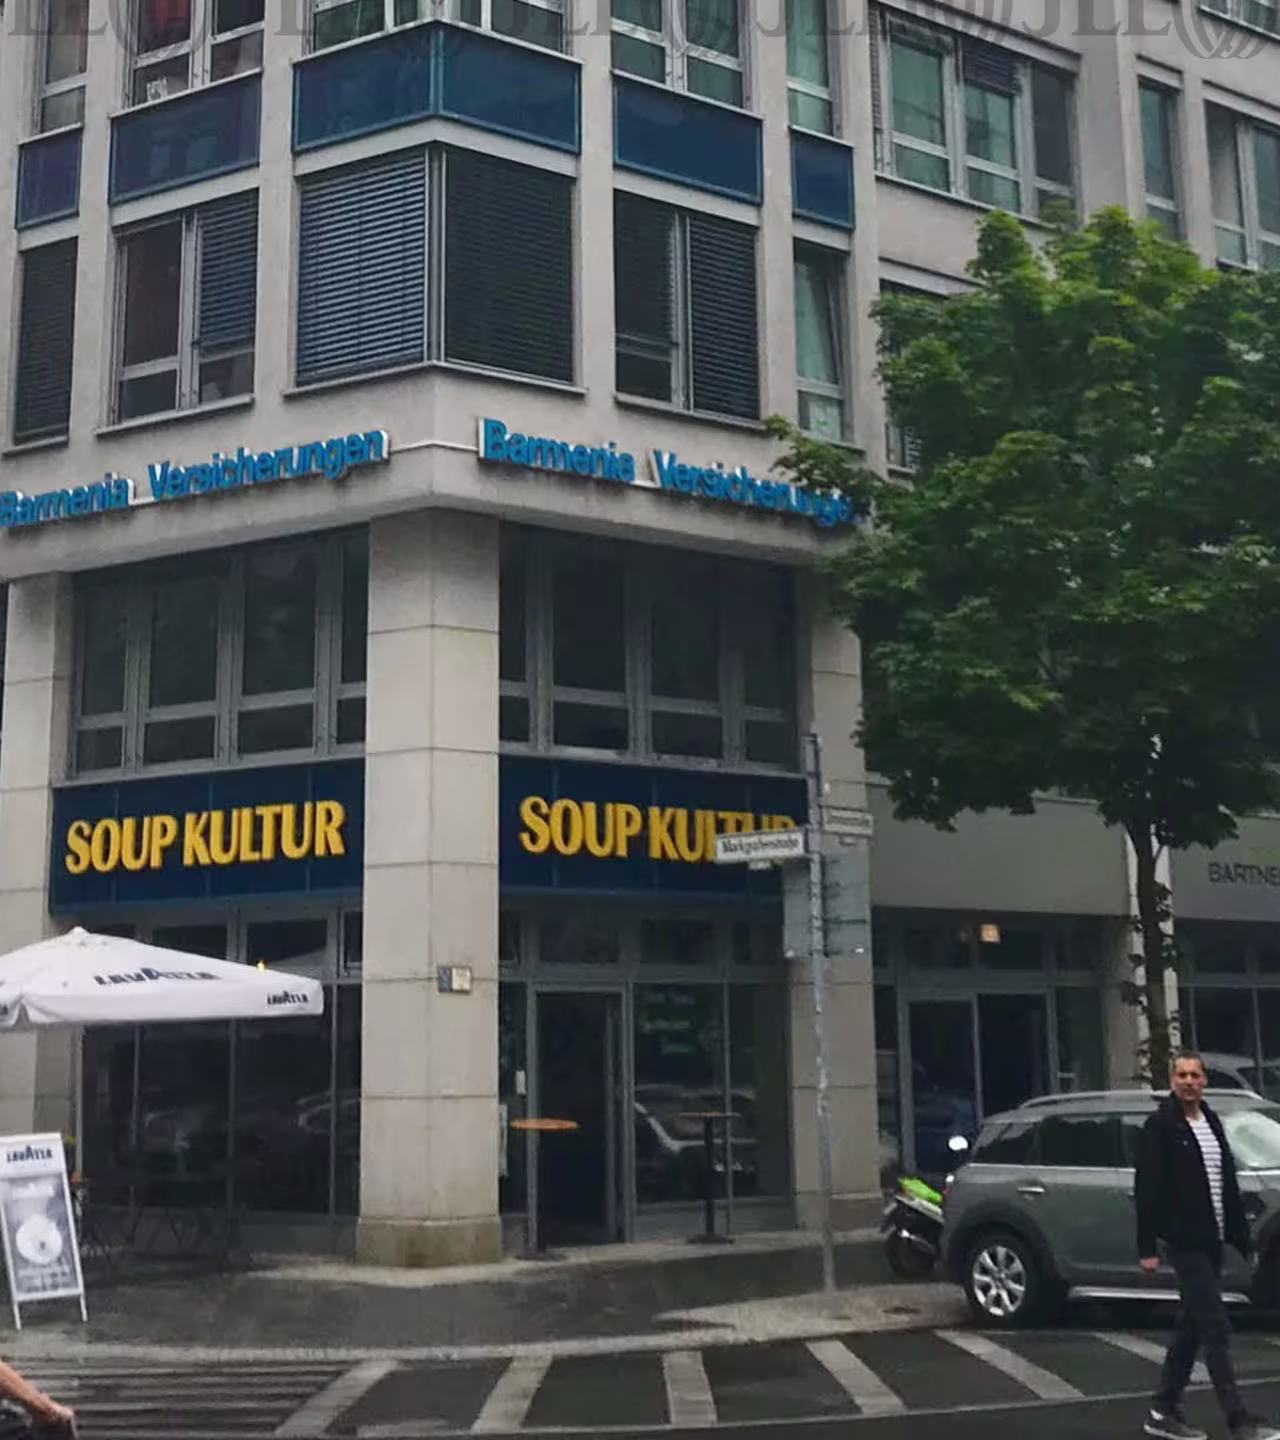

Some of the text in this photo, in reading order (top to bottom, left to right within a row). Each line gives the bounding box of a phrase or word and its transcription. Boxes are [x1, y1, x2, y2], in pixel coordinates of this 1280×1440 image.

[148, 429, 388, 499] Versicherungen
[483, 417, 635, 483] Barmenia
[64, 799, 347, 875] SOUP KULTUR
[519, 795, 643, 859] SOUP
